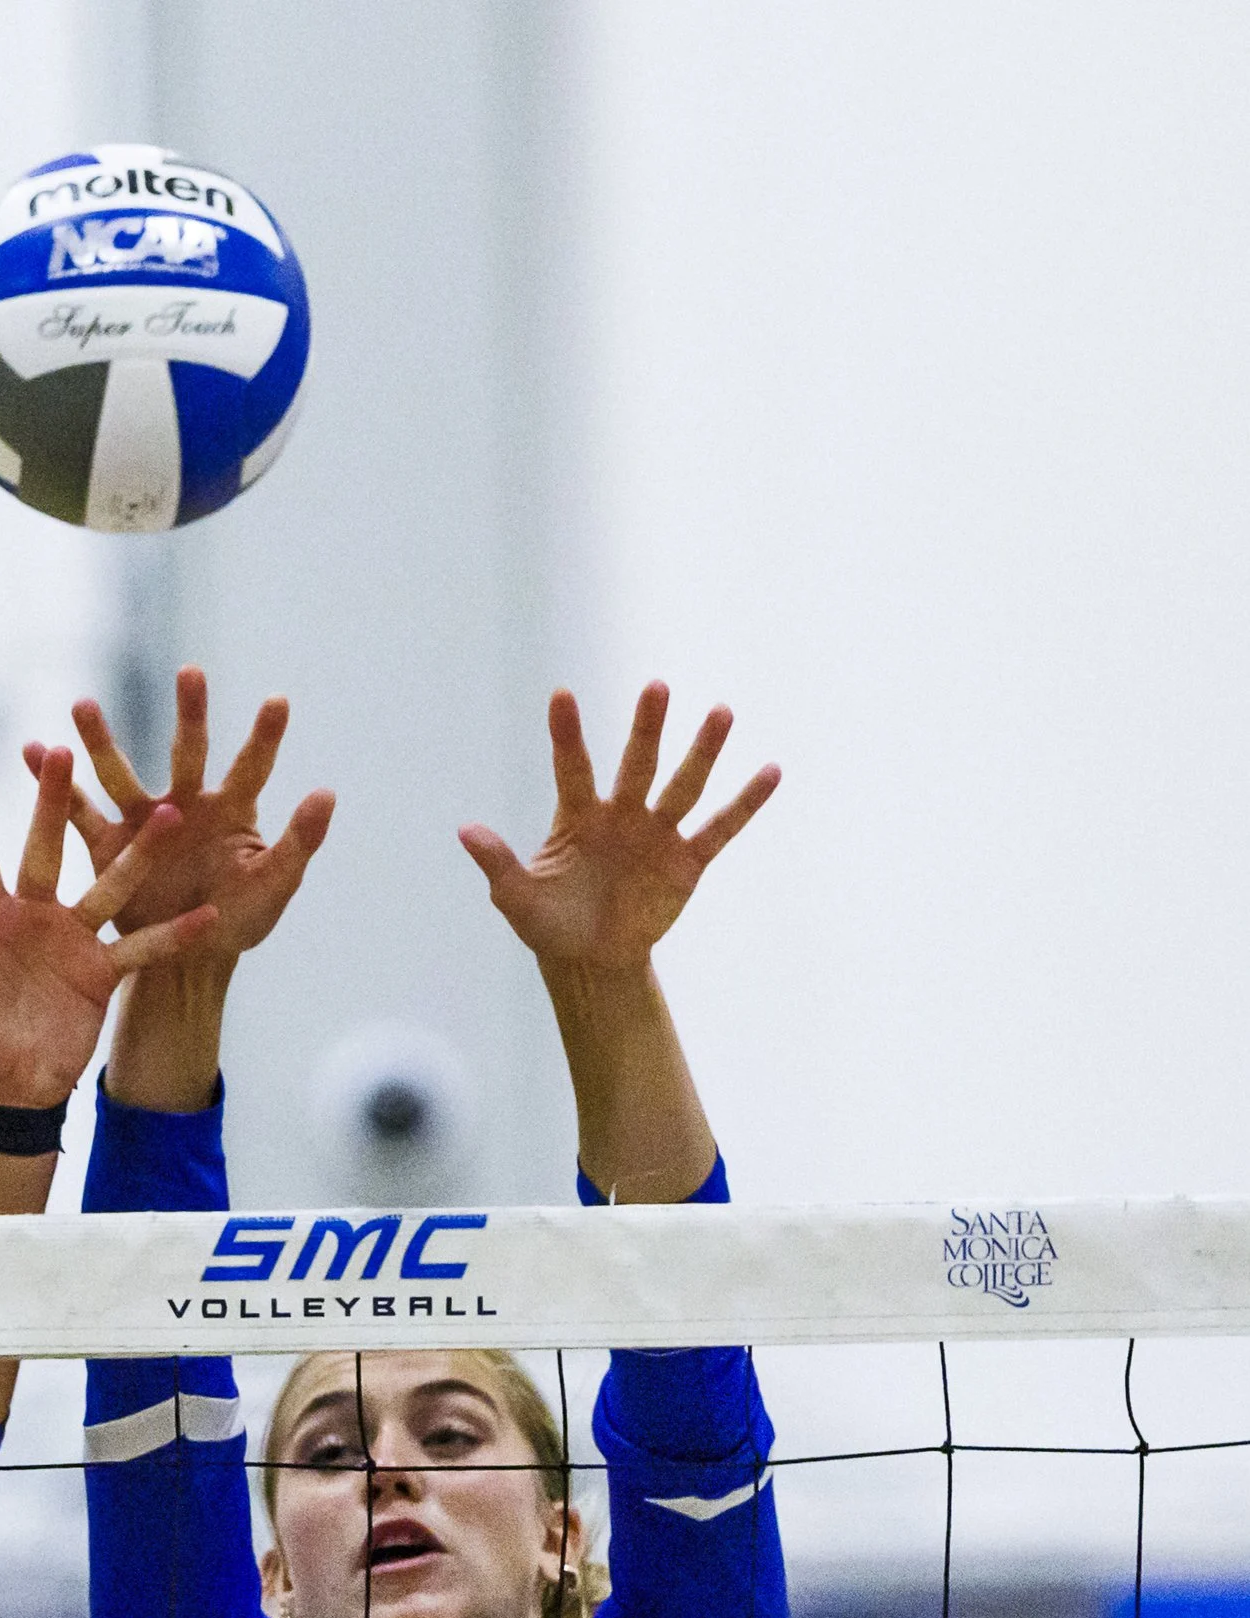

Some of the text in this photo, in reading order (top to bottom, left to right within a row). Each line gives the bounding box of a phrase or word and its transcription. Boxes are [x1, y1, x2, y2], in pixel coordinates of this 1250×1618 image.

[28, 168, 235, 218] molten
[47, 215, 229, 280] NCAA
[37, 299, 237, 350] Super Touch
[951, 1206, 1048, 1236] SANTA
[200, 1214, 488, 1282] SMC
[943, 1236, 1059, 1262] MONICA
[167, 1295, 498, 1319] VOLLEYBALL
[947, 1261, 1052, 1308] COLLEGE
